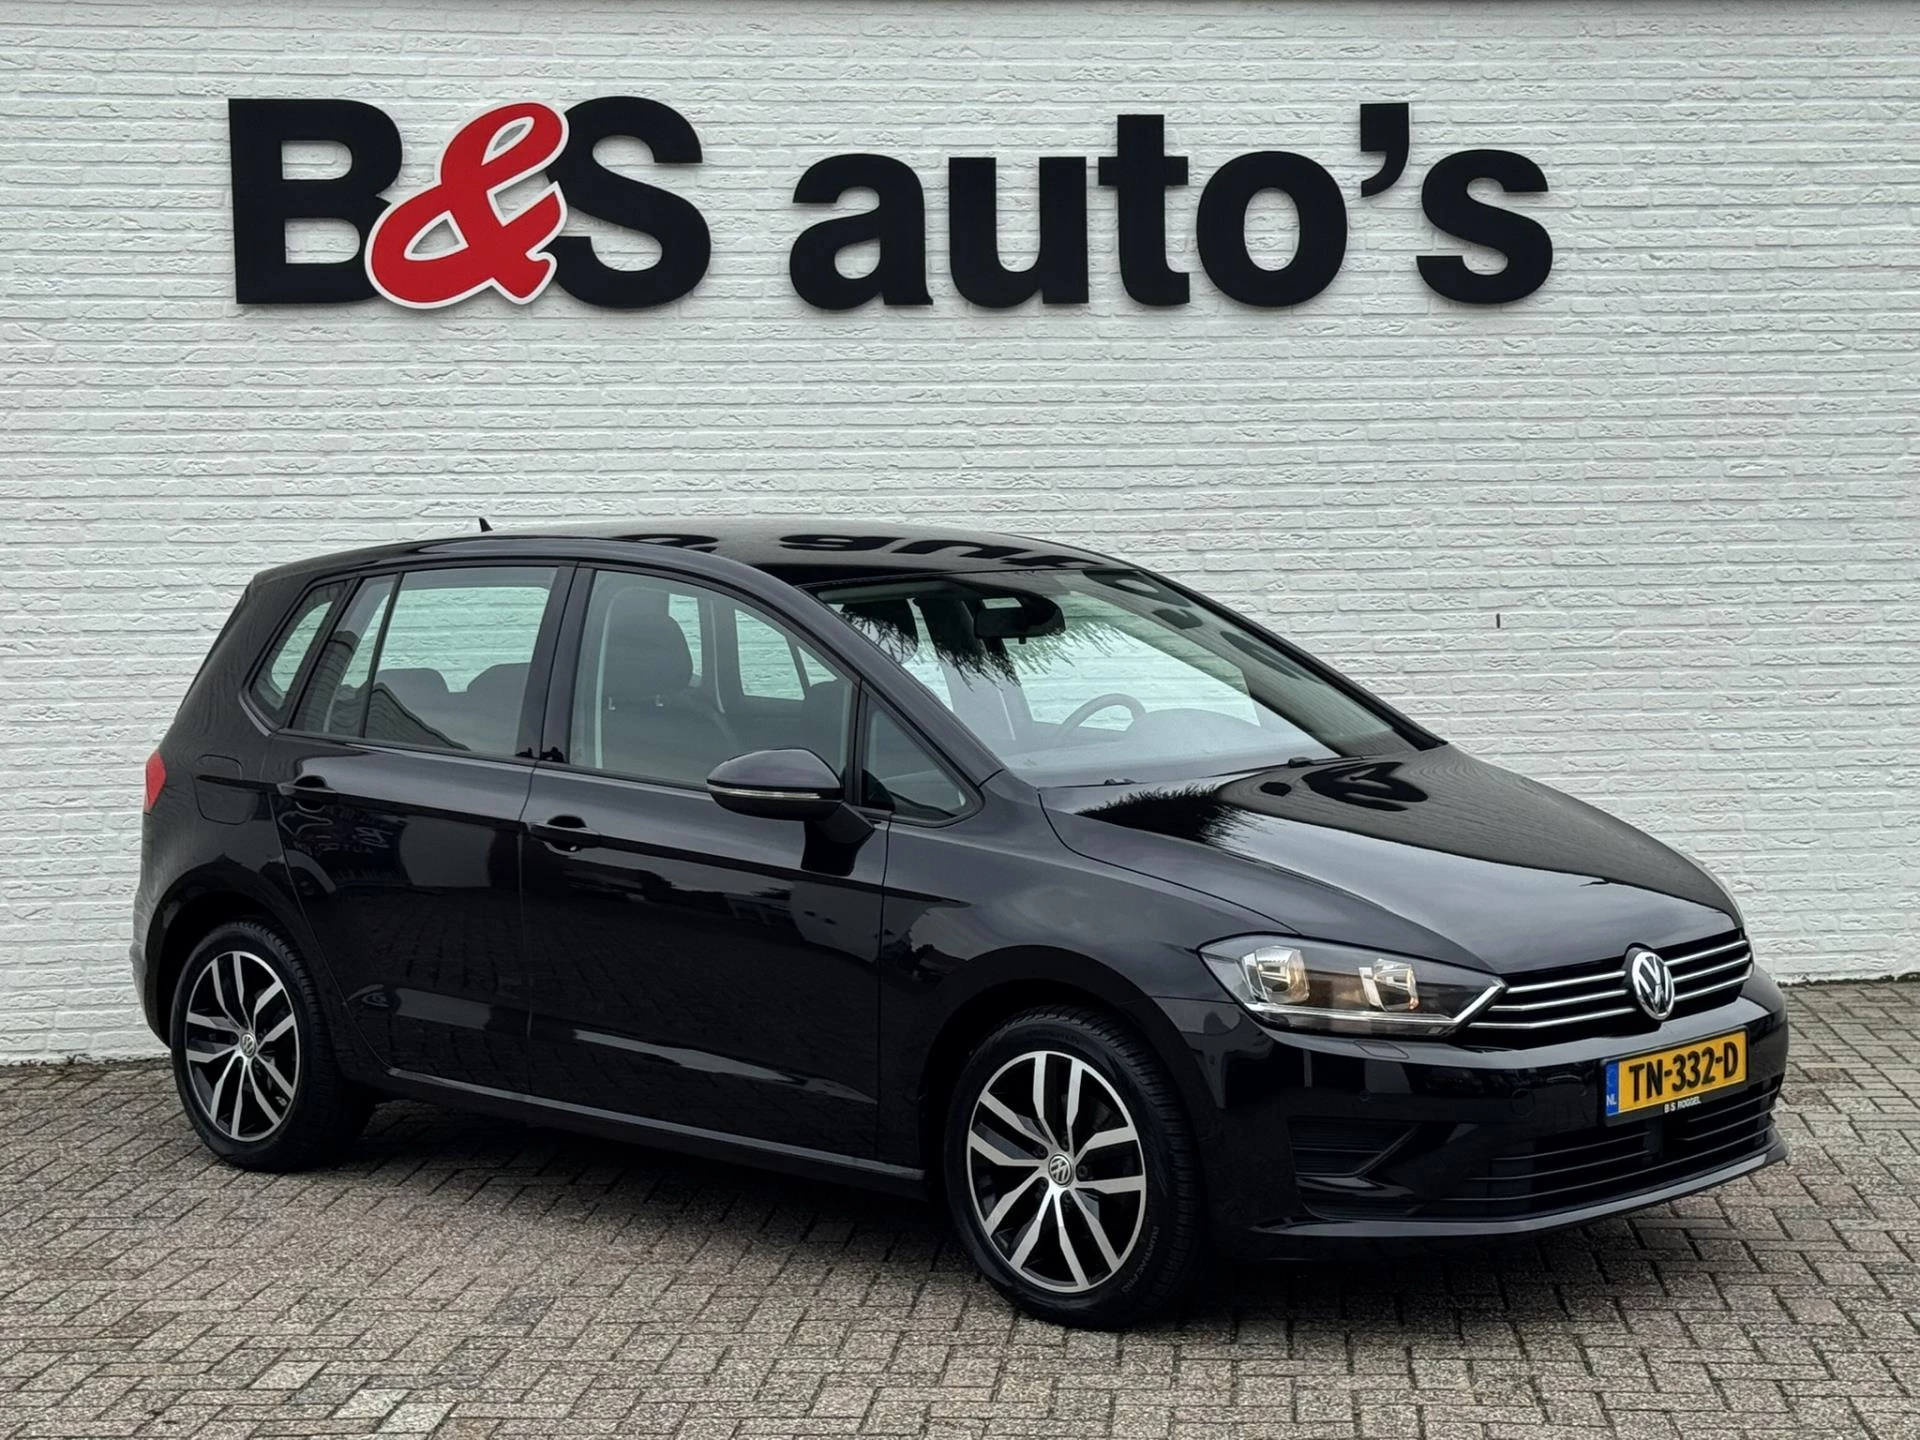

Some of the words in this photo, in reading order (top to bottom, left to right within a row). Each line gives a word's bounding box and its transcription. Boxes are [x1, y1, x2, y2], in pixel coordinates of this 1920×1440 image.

[228, 96, 711, 311] B&S
[789, 103, 1554, 310] auto's
[1606, 1094, 1617, 1106] NL
[1629, 1042, 1738, 1102] TN-332-D
